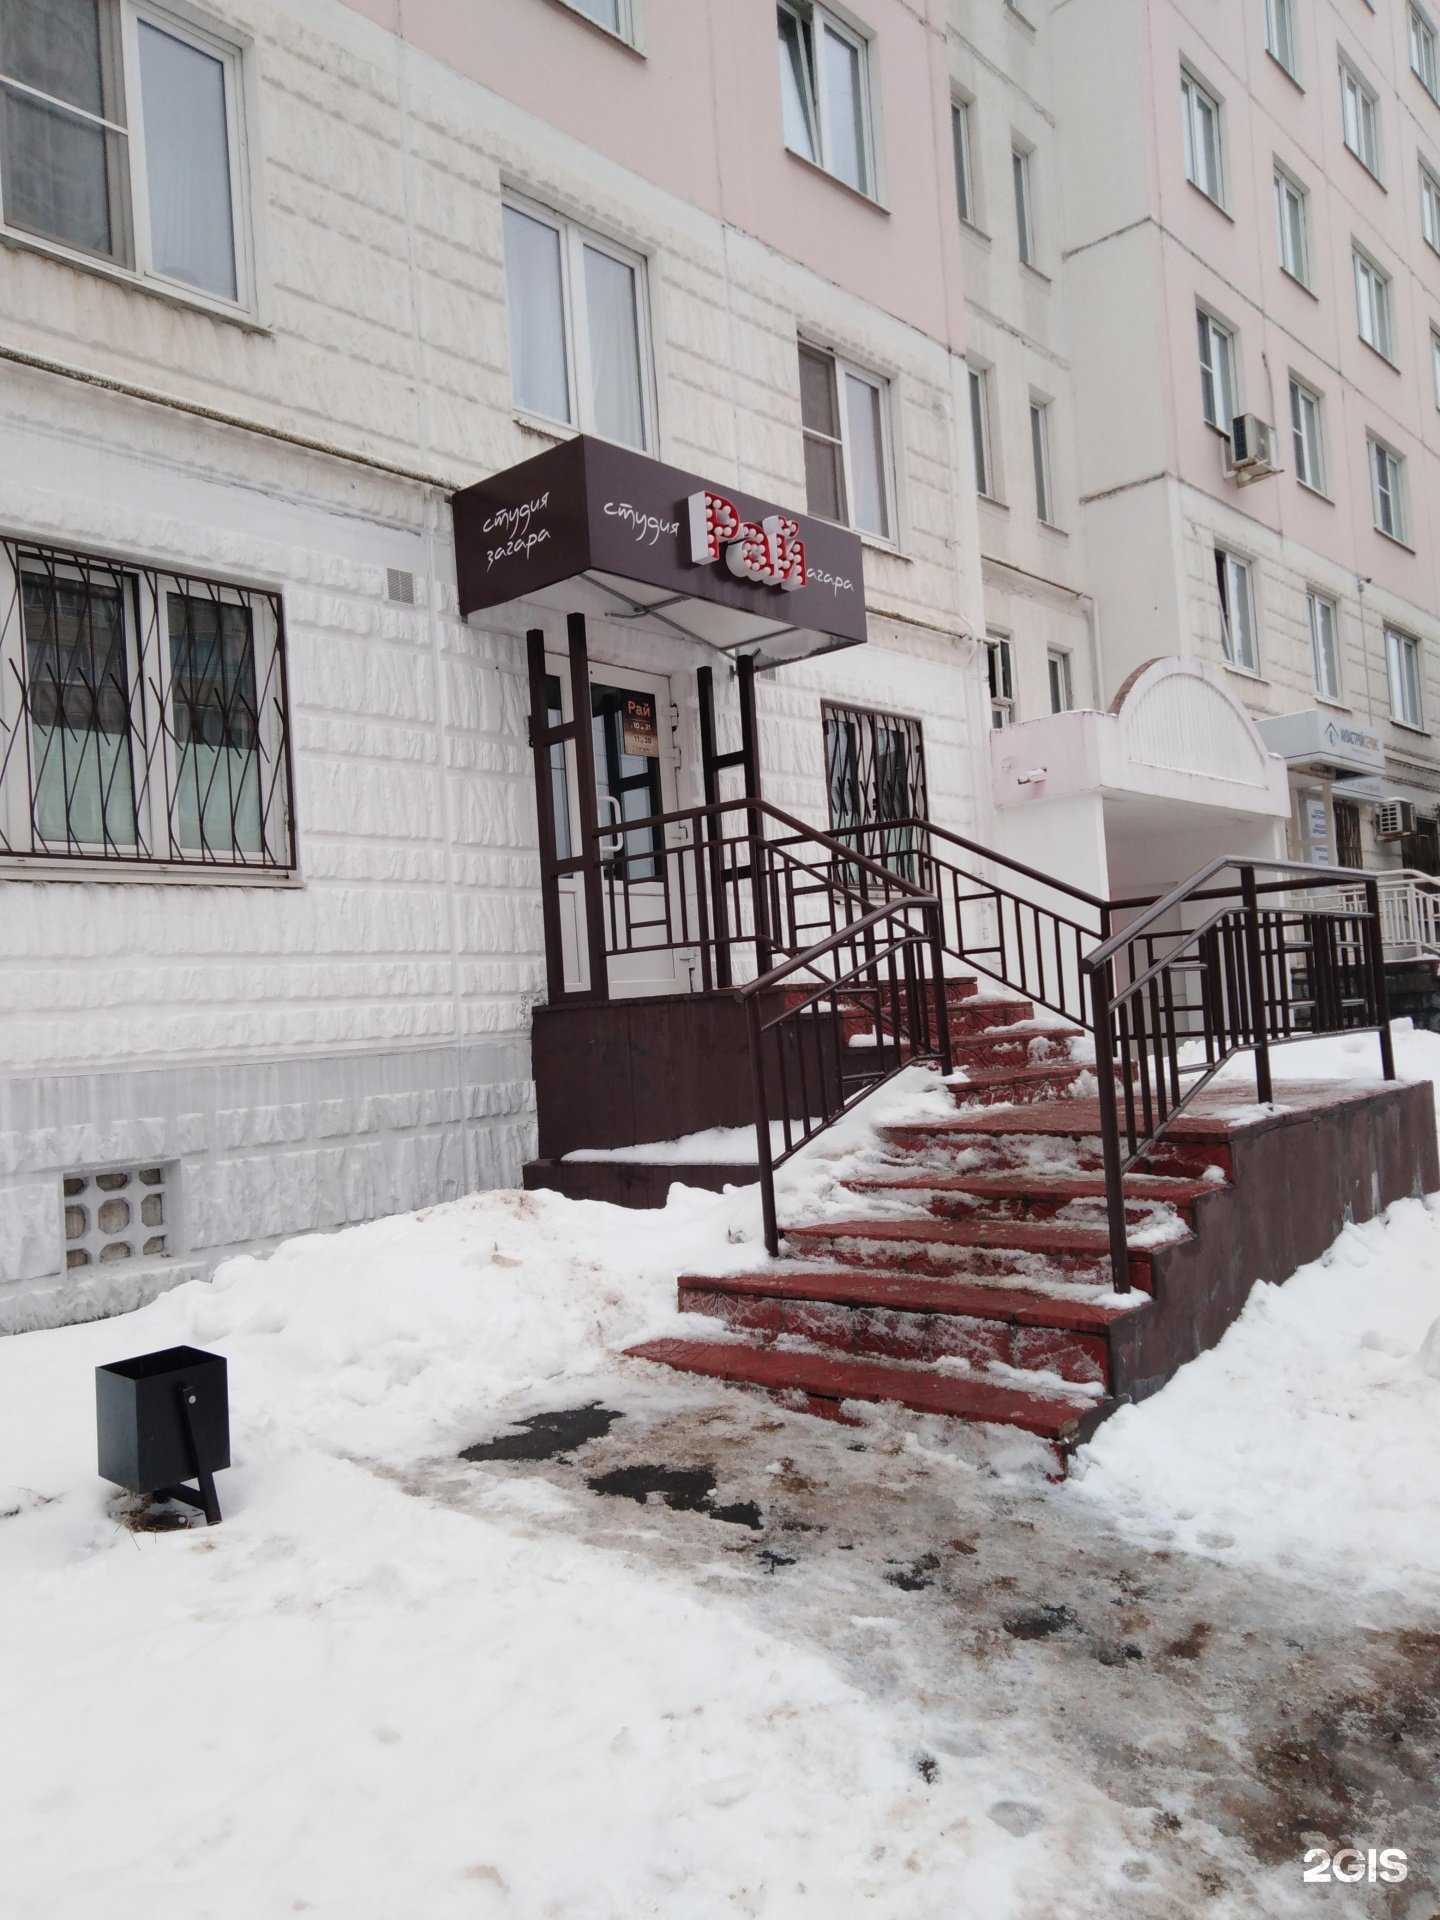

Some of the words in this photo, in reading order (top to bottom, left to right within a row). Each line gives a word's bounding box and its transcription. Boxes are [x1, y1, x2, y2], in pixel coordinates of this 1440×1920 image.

[482, 490, 550, 539] студия
[486, 527, 552, 573] загара
[603, 501, 681, 547] студия
[688, 490, 807, 591] Рай
[806, 567, 856, 599] агара
[627, 700, 650, 717] Рай
